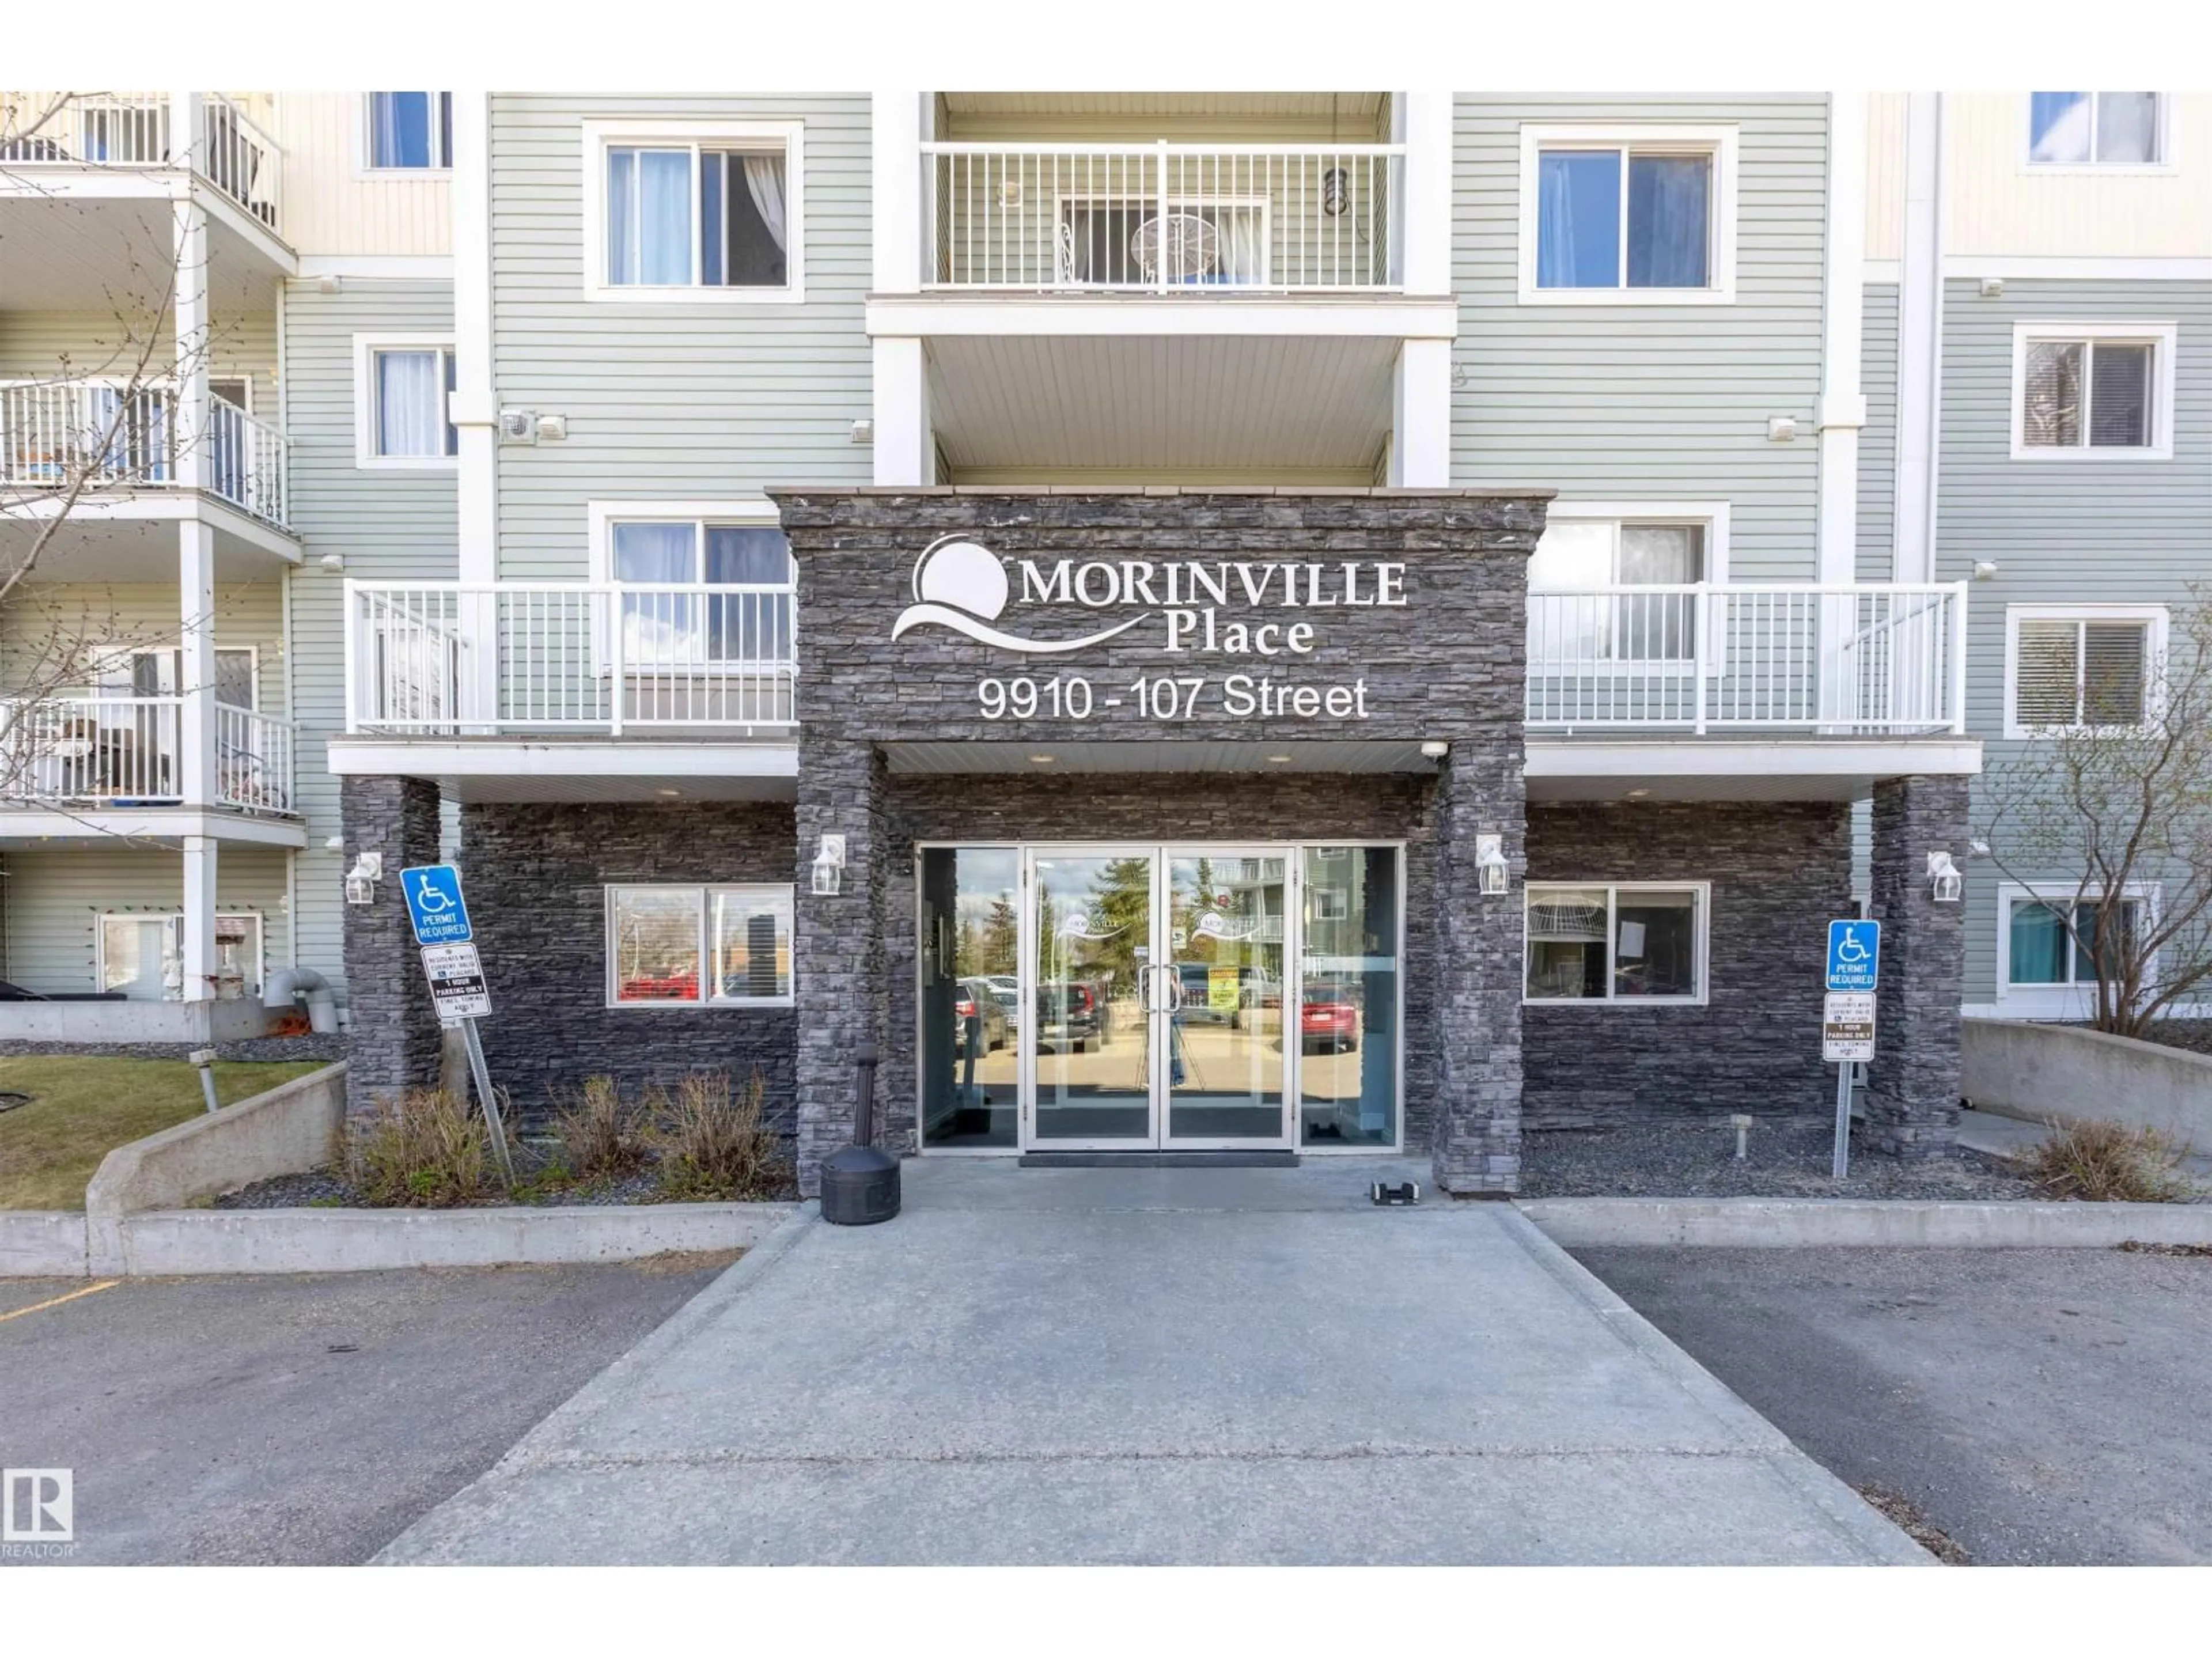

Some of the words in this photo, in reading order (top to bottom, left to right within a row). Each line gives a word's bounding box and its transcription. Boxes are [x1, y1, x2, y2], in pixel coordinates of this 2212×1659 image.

[1018, 559, 1408, 607] MORINVILLE
[1164, 609, 1315, 655] Place
[978, 677, 1092, 719] 9910
[1130, 677, 1205, 719] 107
[1224, 674, 1369, 718] Street
[422, 913, 457, 926] PERMIT
[419, 924, 467, 938] REQUIRED
[1836, 964, 1868, 974] PERMIT
[452, 978, 470, 986] HOUR
[1830, 975, 1873, 984] REQUIRED
[437, 987, 465, 996] PARKING
[466, 986, 483, 994] ONLY
